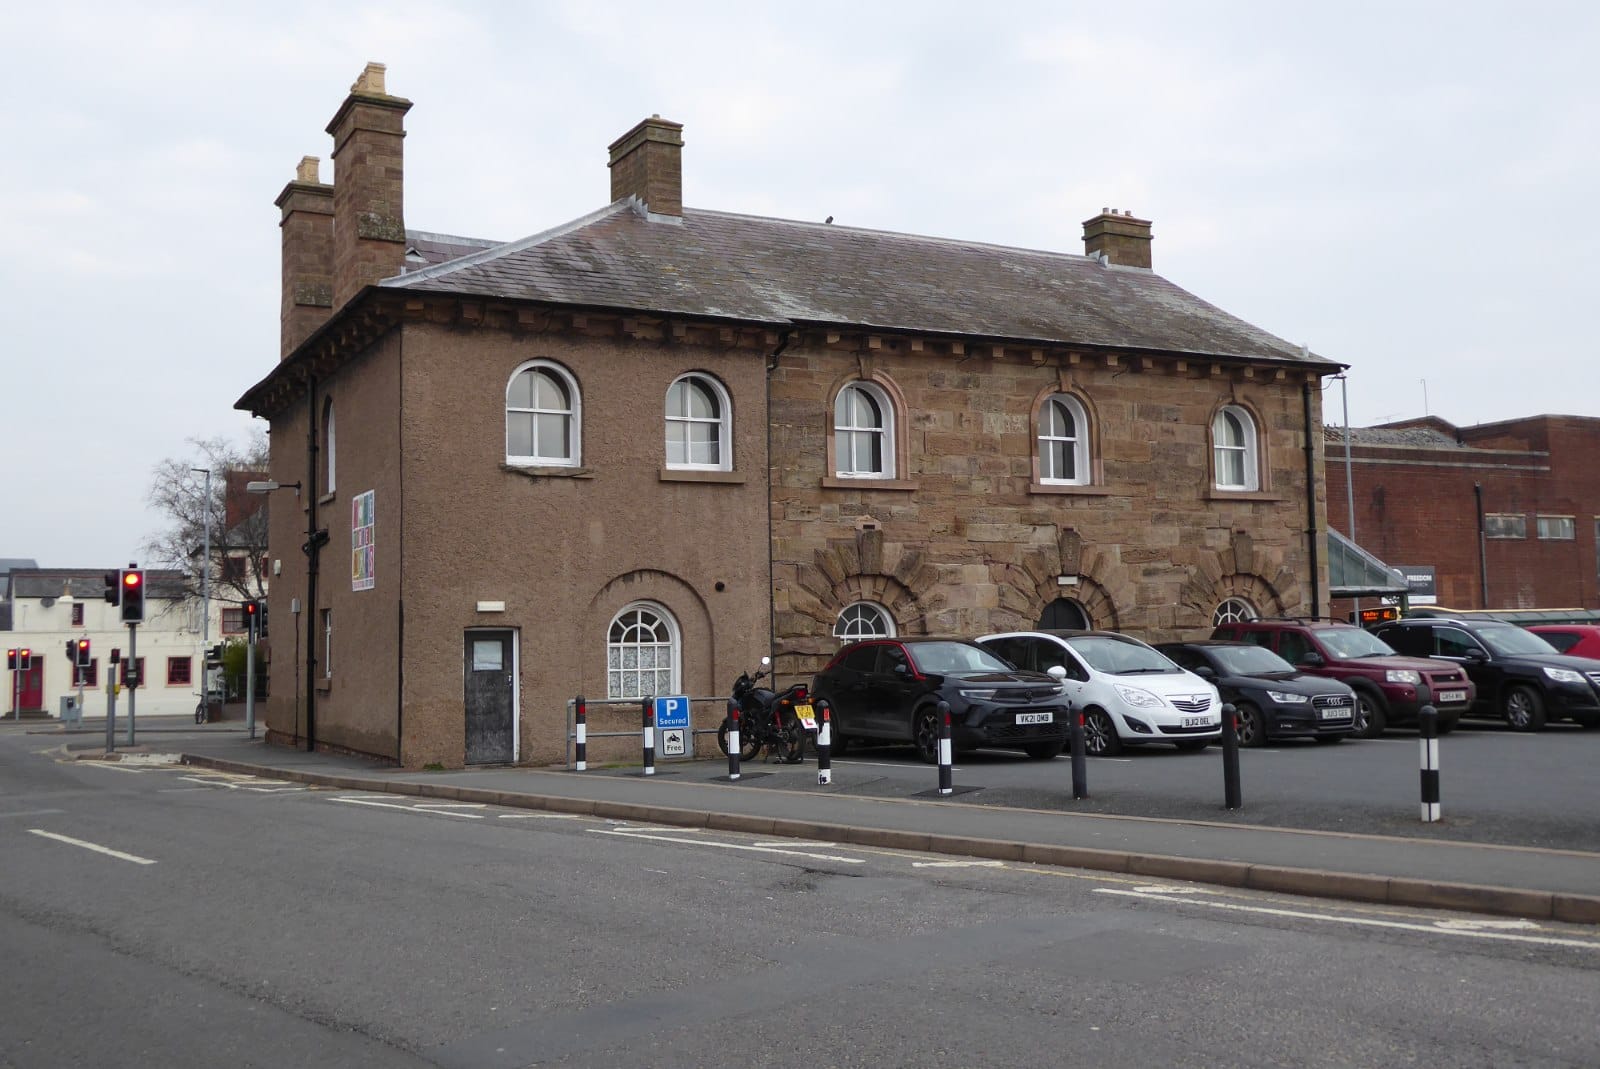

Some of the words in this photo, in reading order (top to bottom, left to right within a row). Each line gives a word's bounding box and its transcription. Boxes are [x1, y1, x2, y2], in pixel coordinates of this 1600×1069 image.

[666, 699, 678, 716] P
[659, 717, 687, 725] Secured
[1020, 714, 1036, 723] VK21
